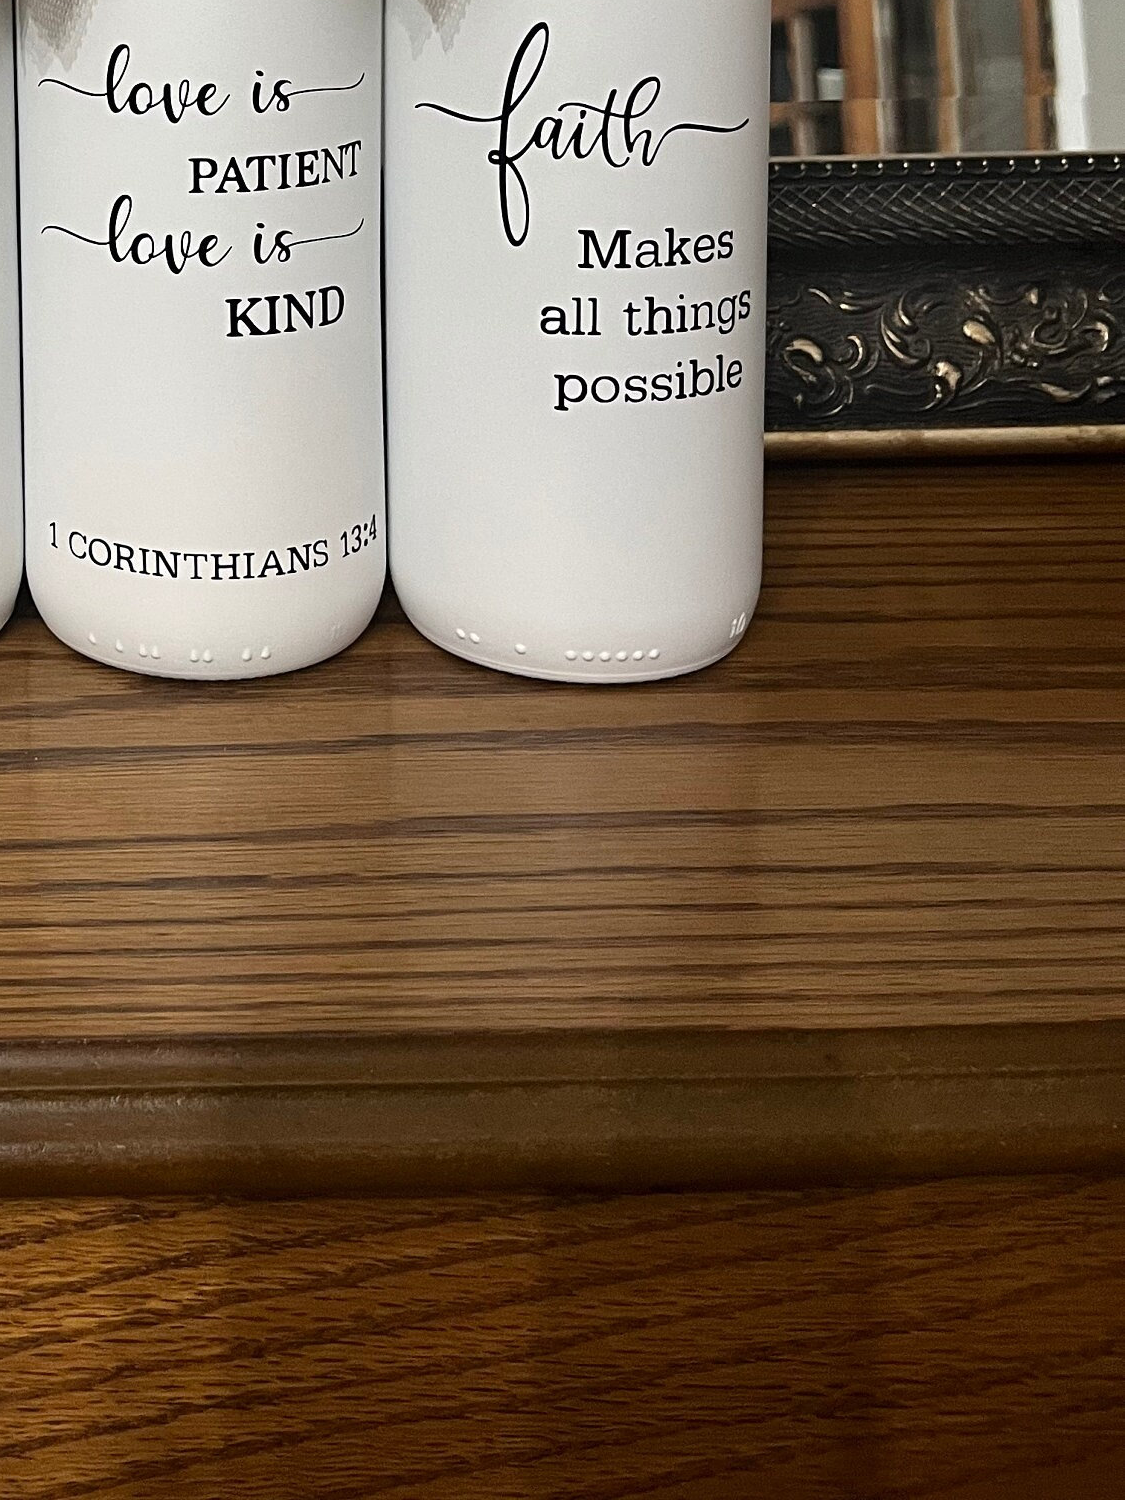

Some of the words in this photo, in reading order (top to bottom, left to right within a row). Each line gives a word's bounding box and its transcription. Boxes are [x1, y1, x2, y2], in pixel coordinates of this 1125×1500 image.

[38, 43, 231, 124] love
[252, 70, 365, 114] is
[415, 22, 750, 247] faith
[188, 139, 362, 194] PATIENT
[41, 194, 233, 275] love
[253, 217, 365, 265] is
[577, 227, 734, 269] Makes
[224, 285, 345, 338] KIND
[540, 297, 602, 337] all
[622, 289, 751, 337] things
[553, 353, 743, 412] possible
[48, 520, 60, 549] 1
[68, 531, 329, 581] CORINTHIANS
[340, 513, 377, 558] 13:4
